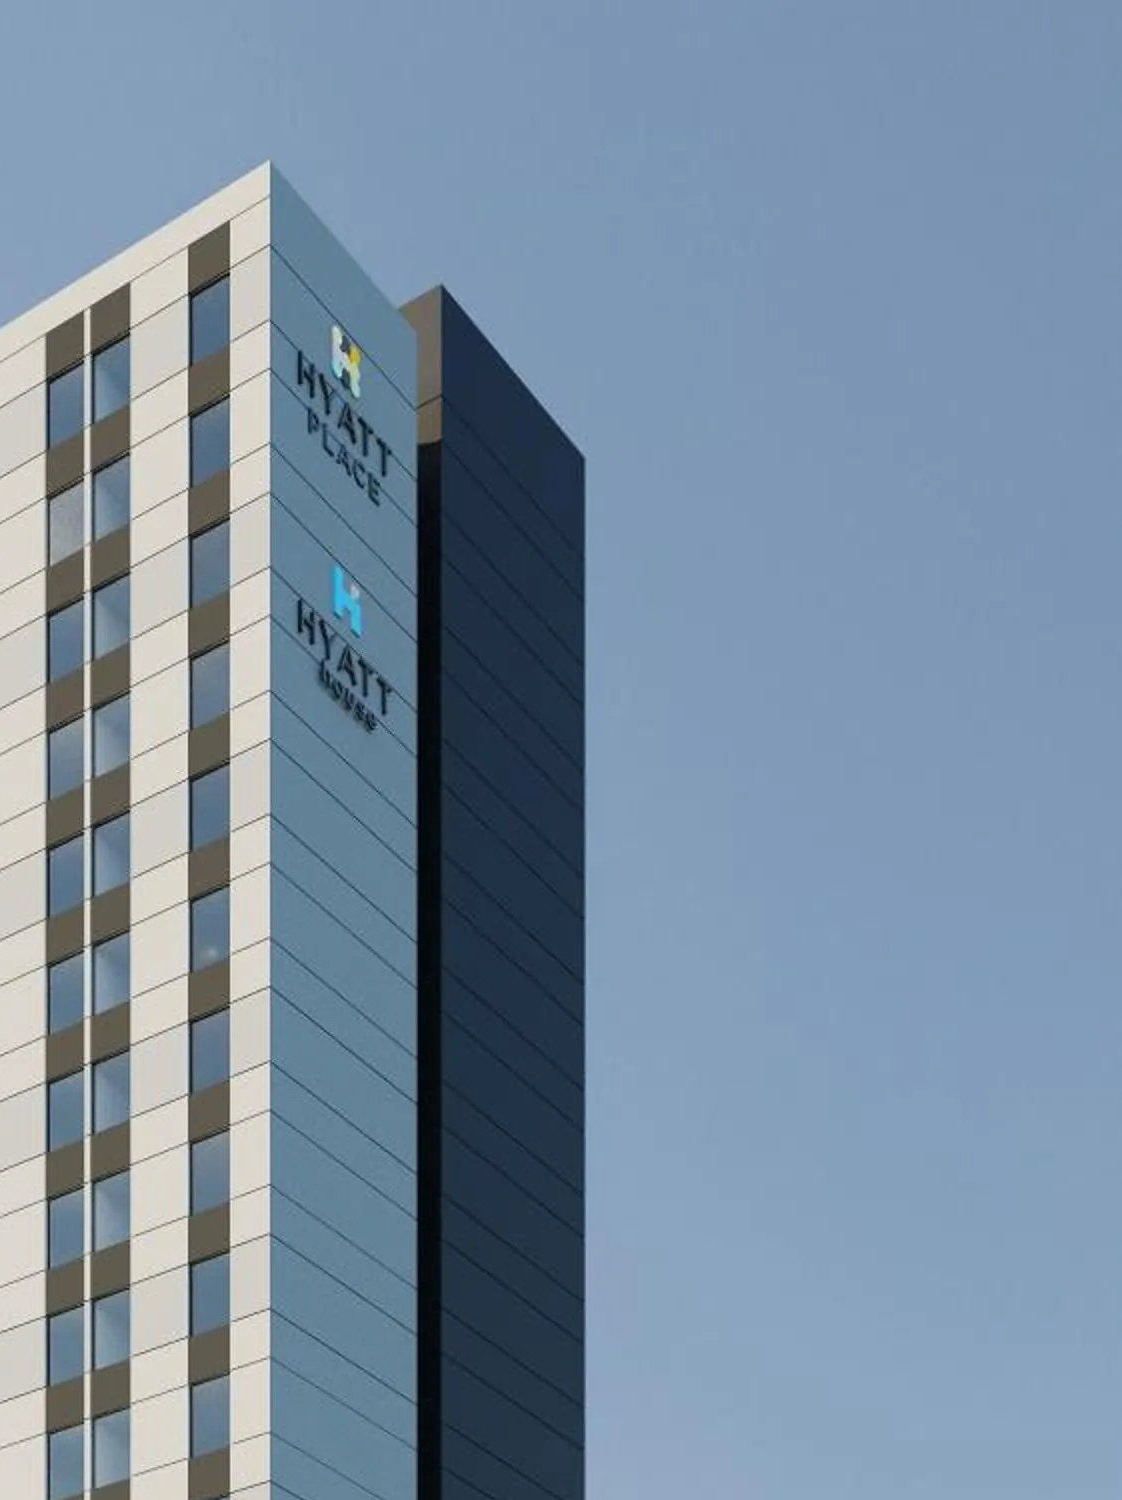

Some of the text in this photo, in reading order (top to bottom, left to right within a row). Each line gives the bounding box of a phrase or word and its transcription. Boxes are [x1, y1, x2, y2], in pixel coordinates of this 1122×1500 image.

[297, 350, 392, 477] HYATT
[308, 407, 380, 507] PLACE
[297, 598, 392, 716] HYATT
